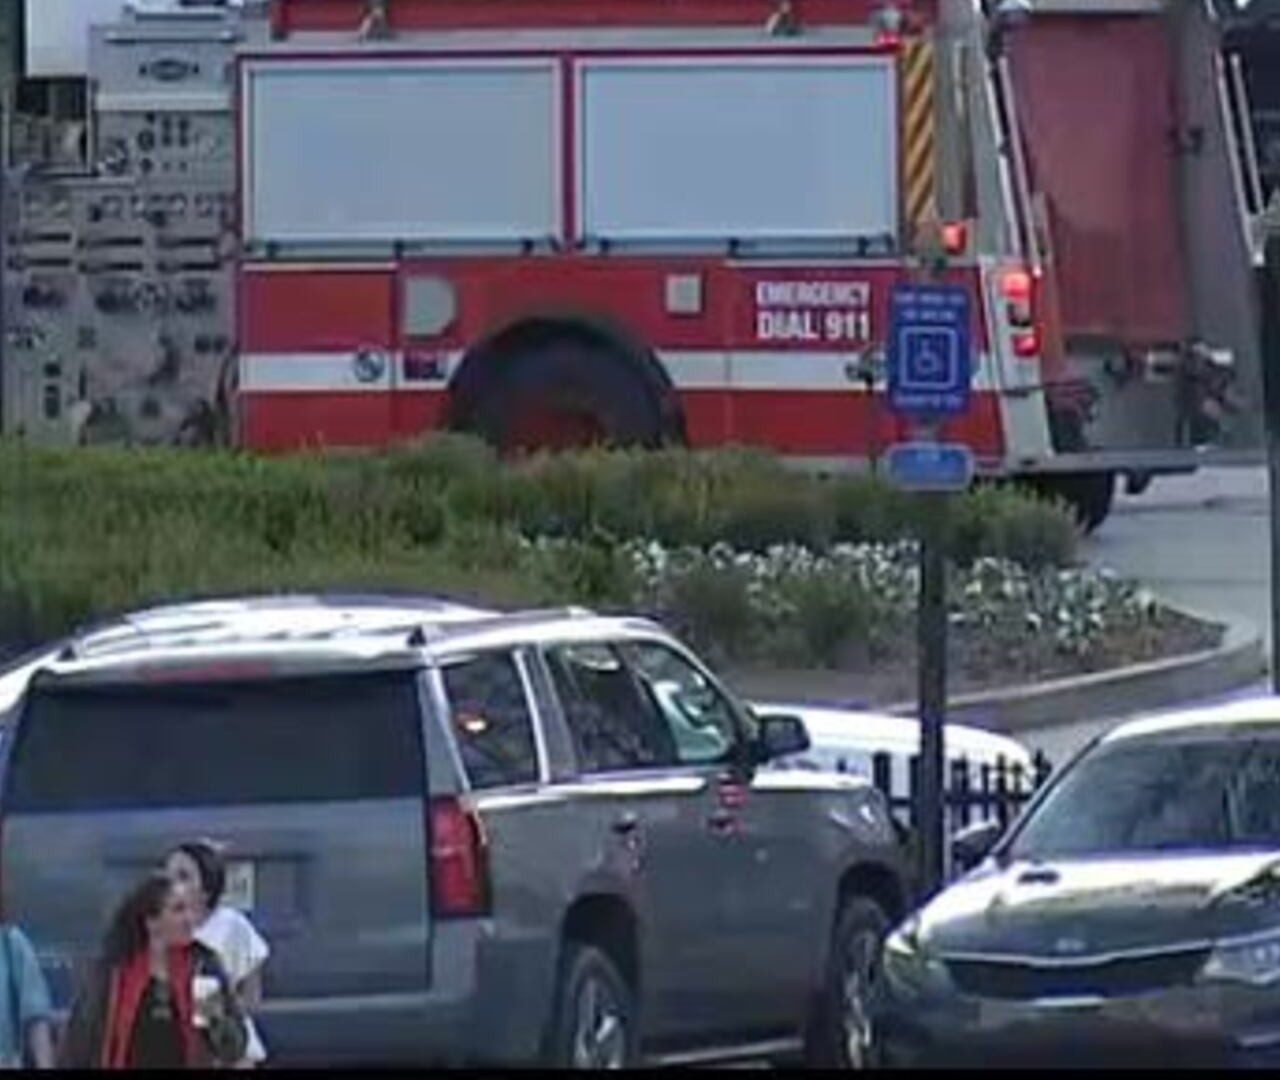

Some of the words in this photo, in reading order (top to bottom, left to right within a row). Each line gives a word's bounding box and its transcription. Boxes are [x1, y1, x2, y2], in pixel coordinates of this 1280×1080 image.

[756, 281, 870, 306] EMERGENCY
[756, 311, 819, 339] DIAL
[825, 310, 870, 339] 911
